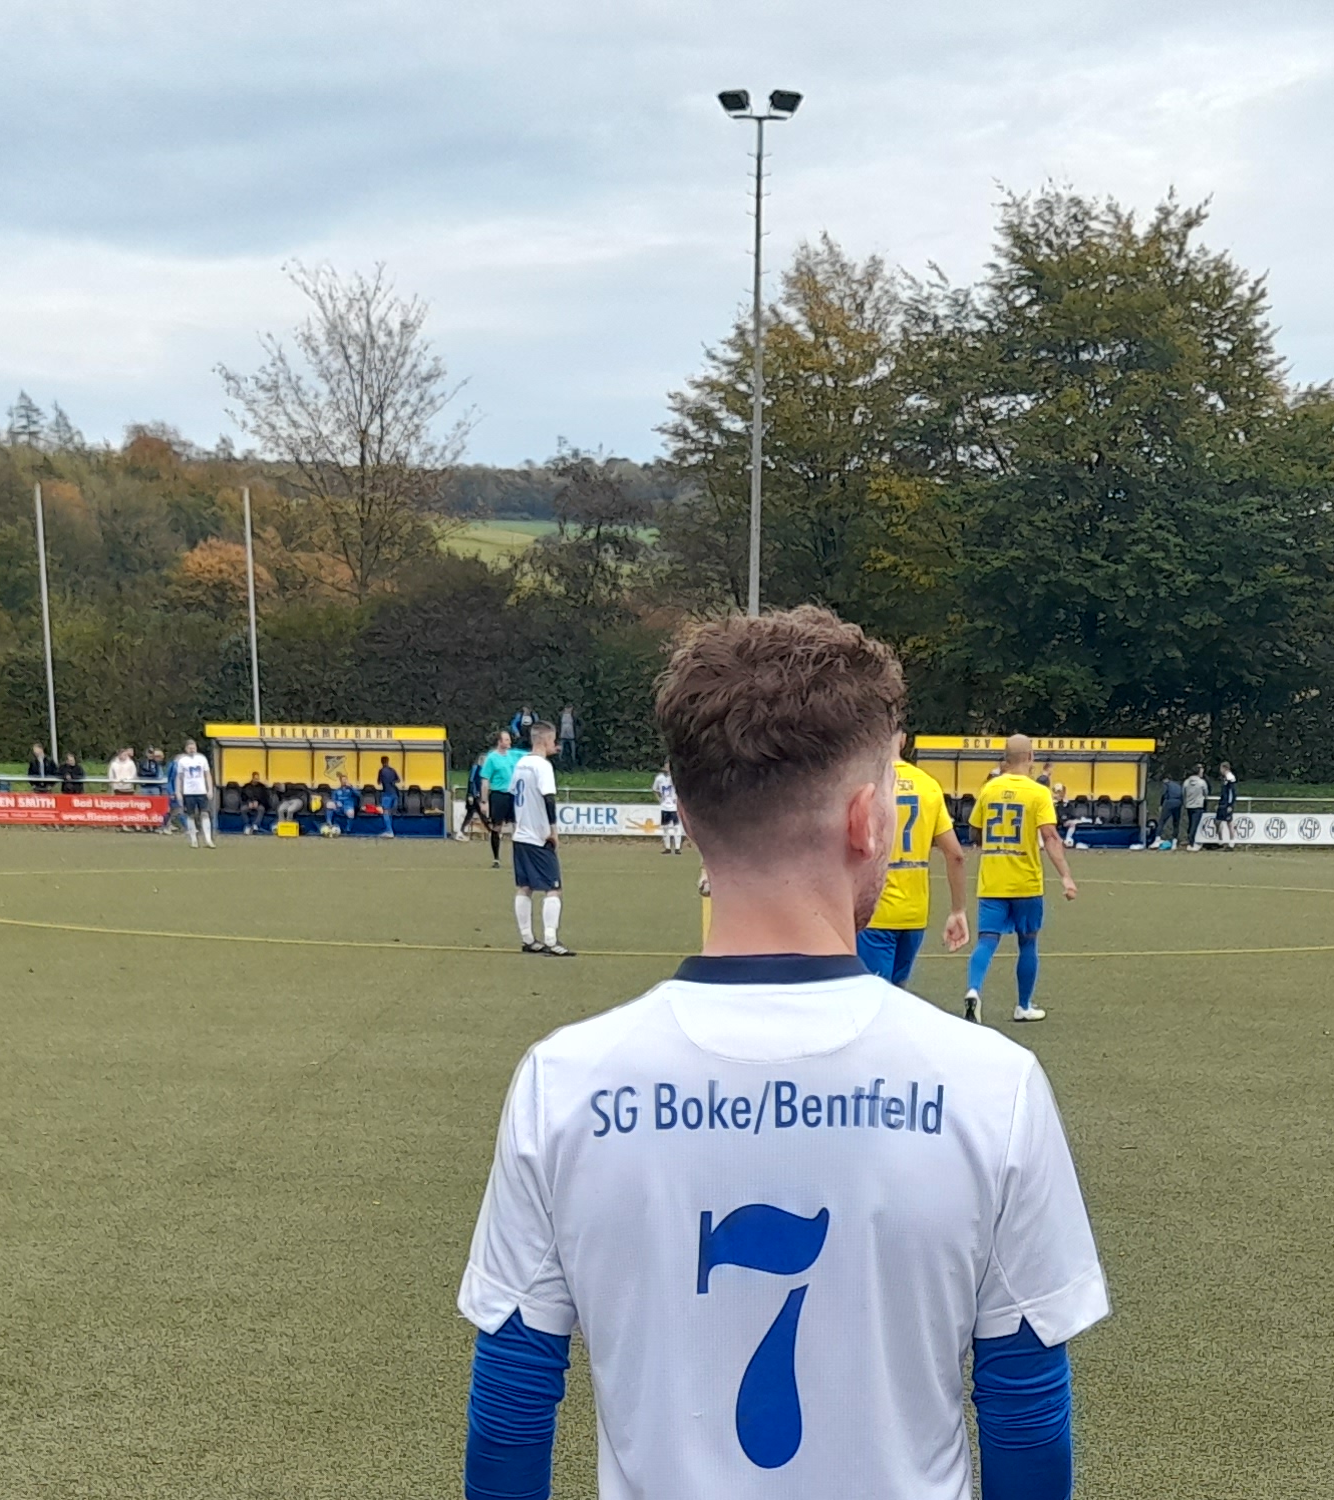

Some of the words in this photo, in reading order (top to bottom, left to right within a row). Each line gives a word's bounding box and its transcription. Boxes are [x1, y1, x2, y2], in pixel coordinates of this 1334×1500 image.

[963, 738, 990, 749] SCV
[17, 797, 56, 809] SMITH
[73, 797, 93, 808] Bad
[95, 798, 152, 811] Lippspringe
[515, 779, 525, 807] 8
[556, 805, 619, 826] CHER
[896, 795, 919, 852] 7
[985, 802, 1025, 845] 23
[590, 1085, 638, 1137] SG
[653, 1078, 945, 1136] Boke/Bentfeld
[696, 1203, 830, 1469] 7
